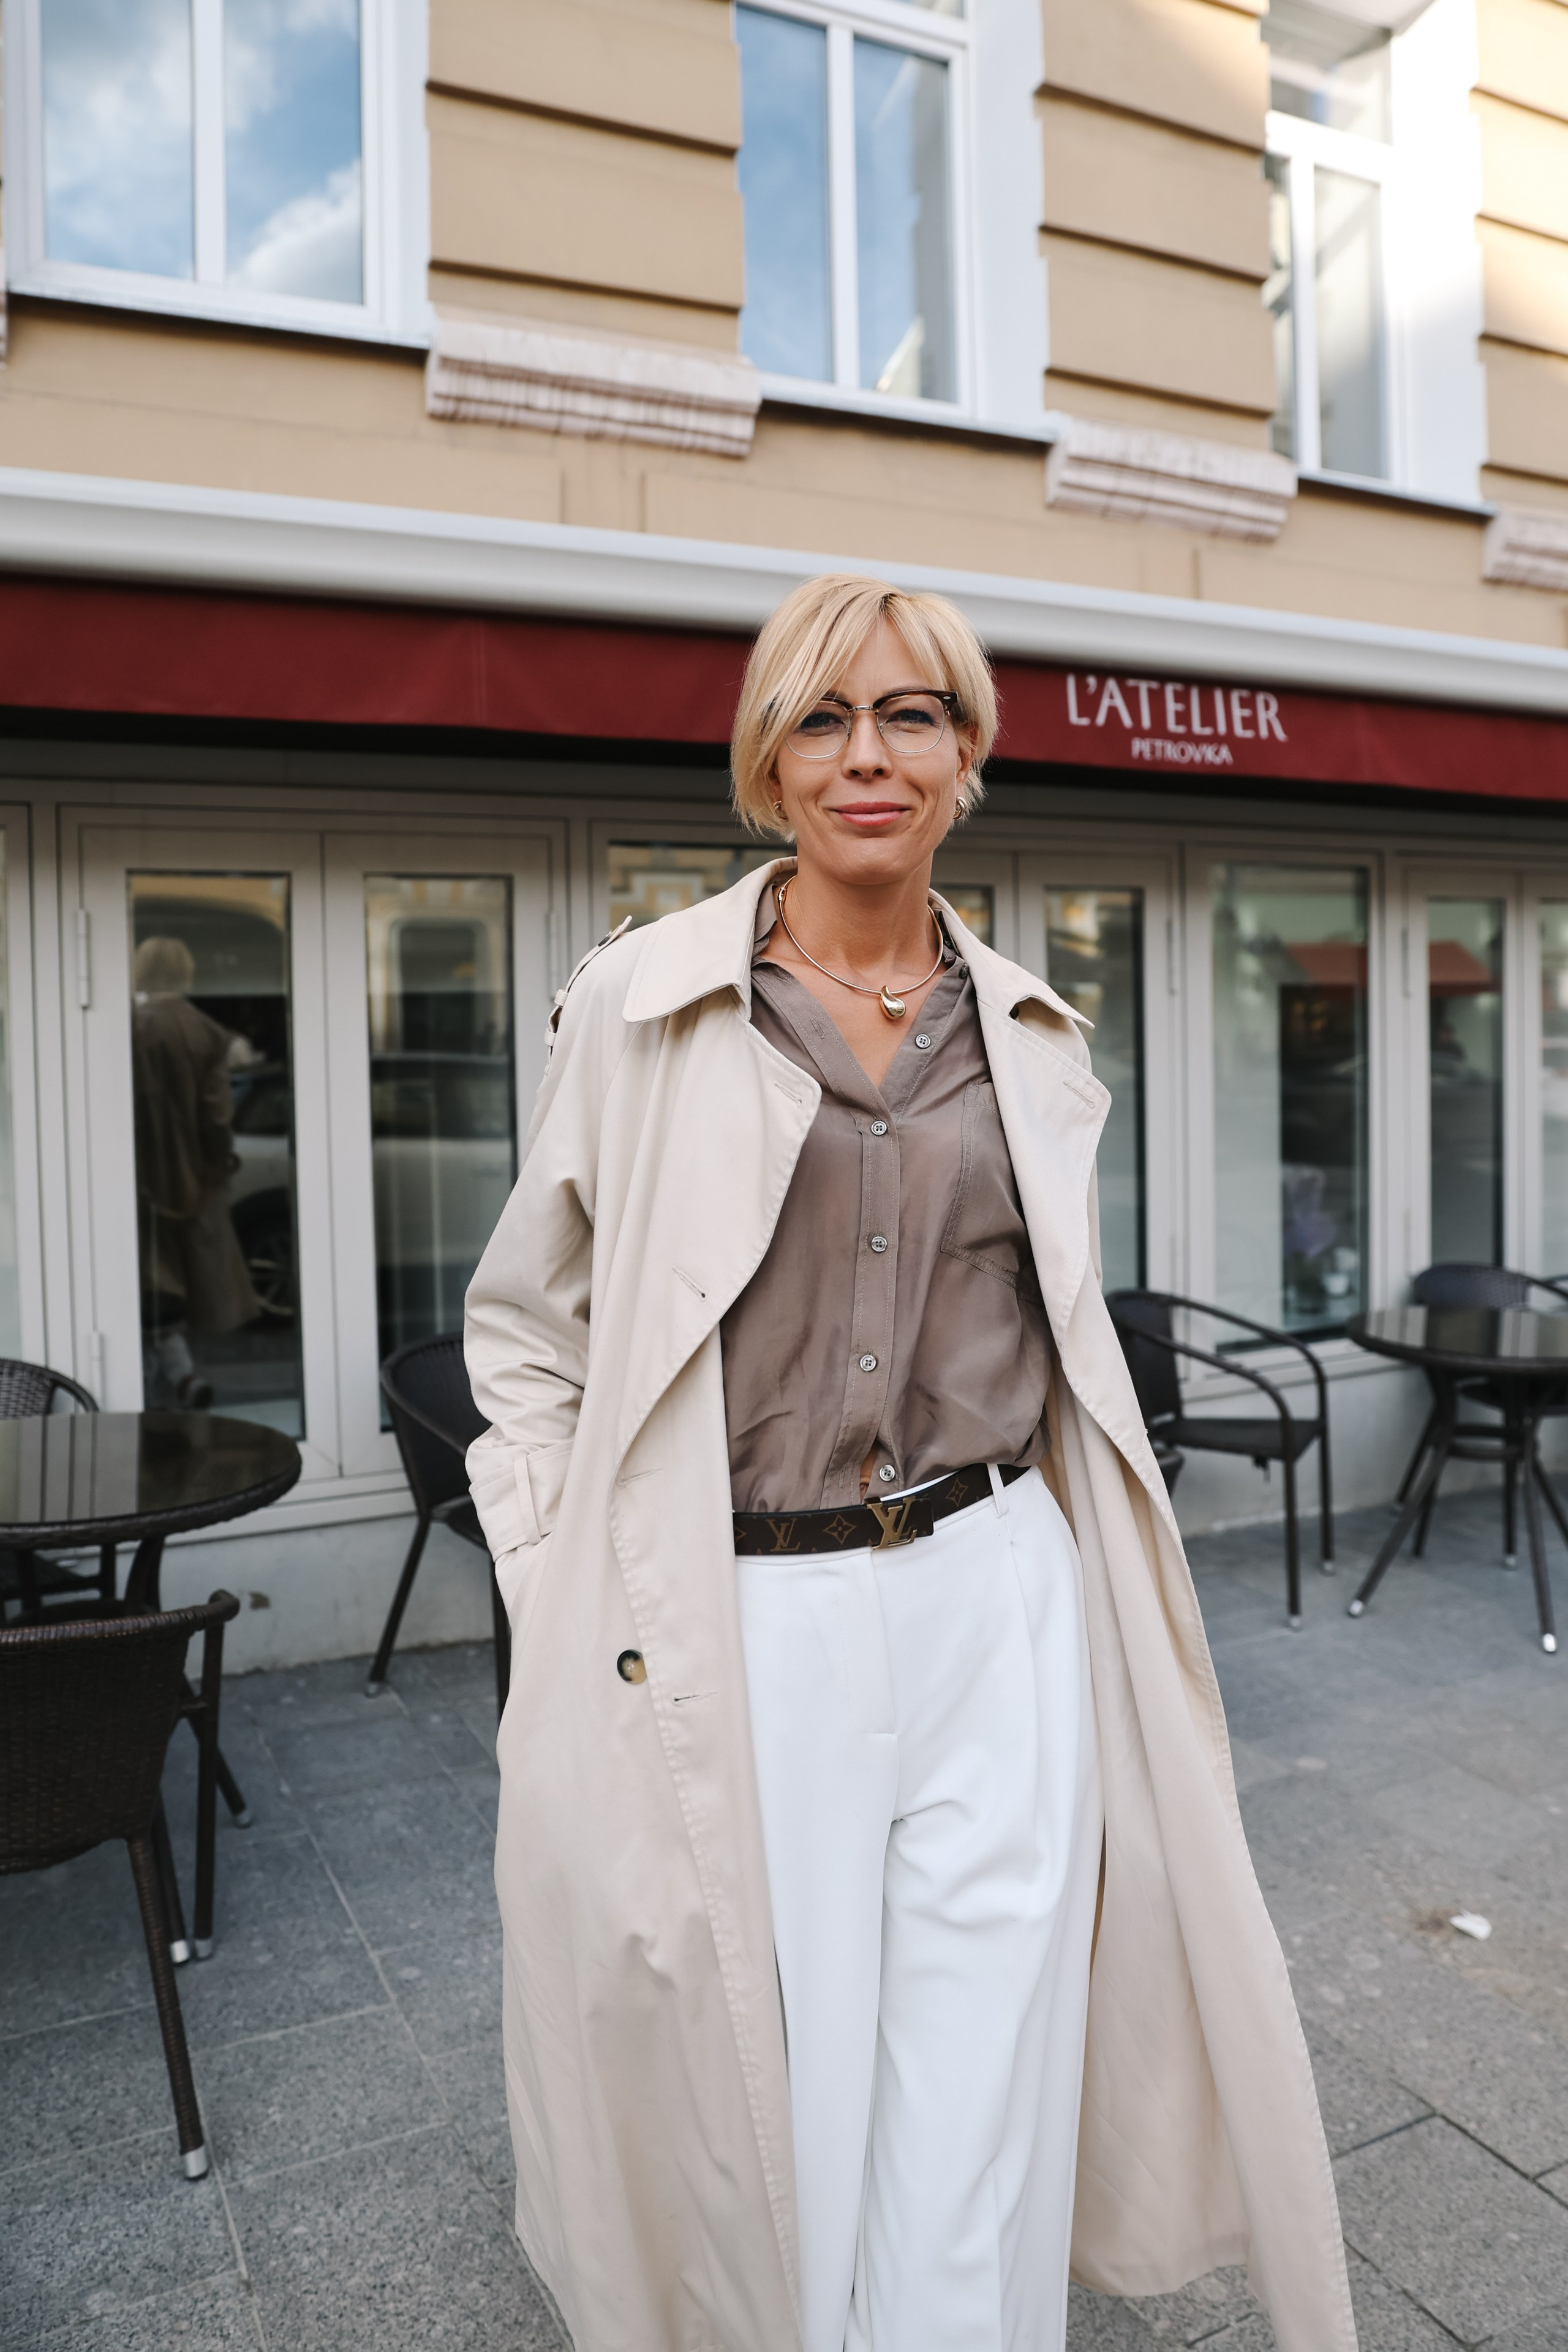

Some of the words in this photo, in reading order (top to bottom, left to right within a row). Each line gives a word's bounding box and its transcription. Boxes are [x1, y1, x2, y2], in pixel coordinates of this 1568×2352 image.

[1066, 674, 1288, 742] L'ATELIER
[1131, 737, 1234, 766] PETROVKA
[867, 1496, 918, 1550] LV
